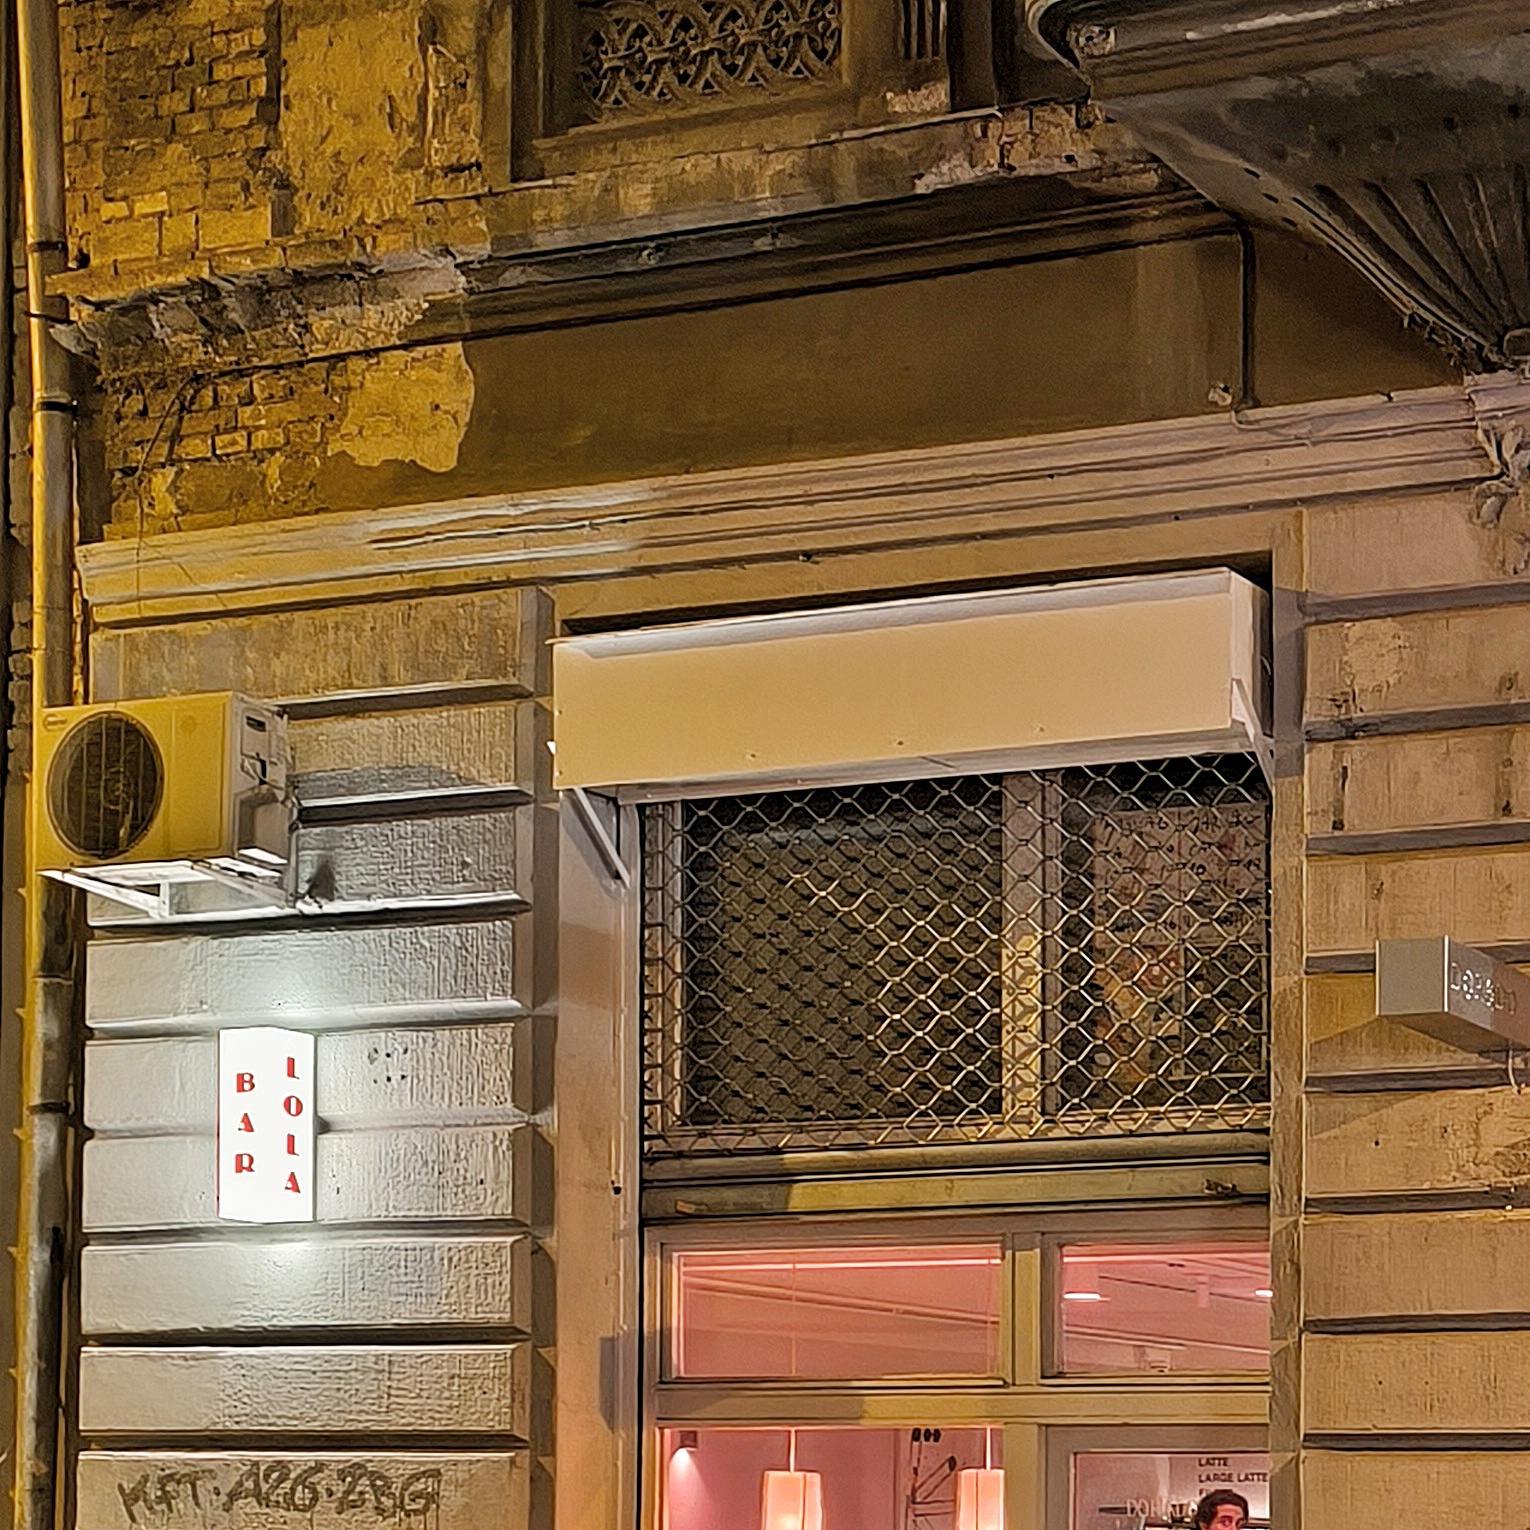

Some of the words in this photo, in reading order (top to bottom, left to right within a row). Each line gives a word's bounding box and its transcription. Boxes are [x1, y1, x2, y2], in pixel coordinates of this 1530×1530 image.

[235, 1072, 255, 1174] BAR
[283, 1056, 304, 1194] LOLA
[1198, 1457, 1229, 1467] LATTE
[1198, 1473, 1234, 1483] LARGE
[1237, 1472, 1269, 1483] LATTE
